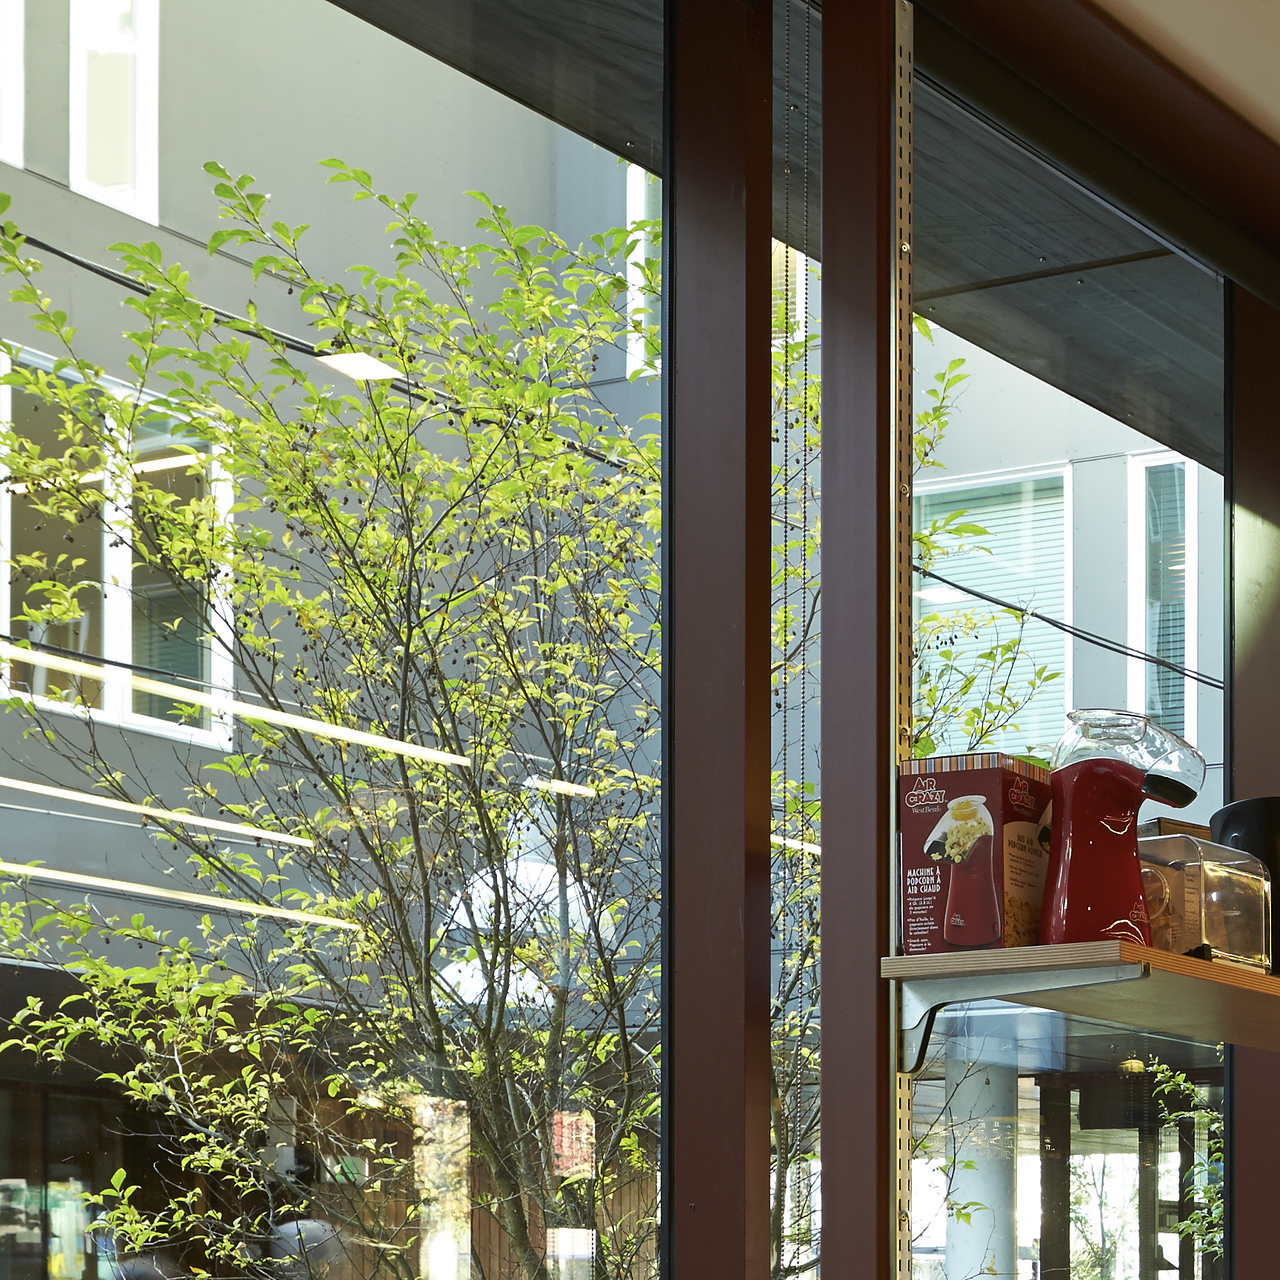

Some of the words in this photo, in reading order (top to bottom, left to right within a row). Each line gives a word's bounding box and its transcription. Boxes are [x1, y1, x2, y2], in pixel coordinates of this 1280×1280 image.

[913, 777, 936, 791] AIR
[905, 790, 946, 807] CRAZY
[907, 867, 934, 877] MACHINE
[907, 876, 934, 885] POPCORN
[920, 884, 941, 893] CHAUD
